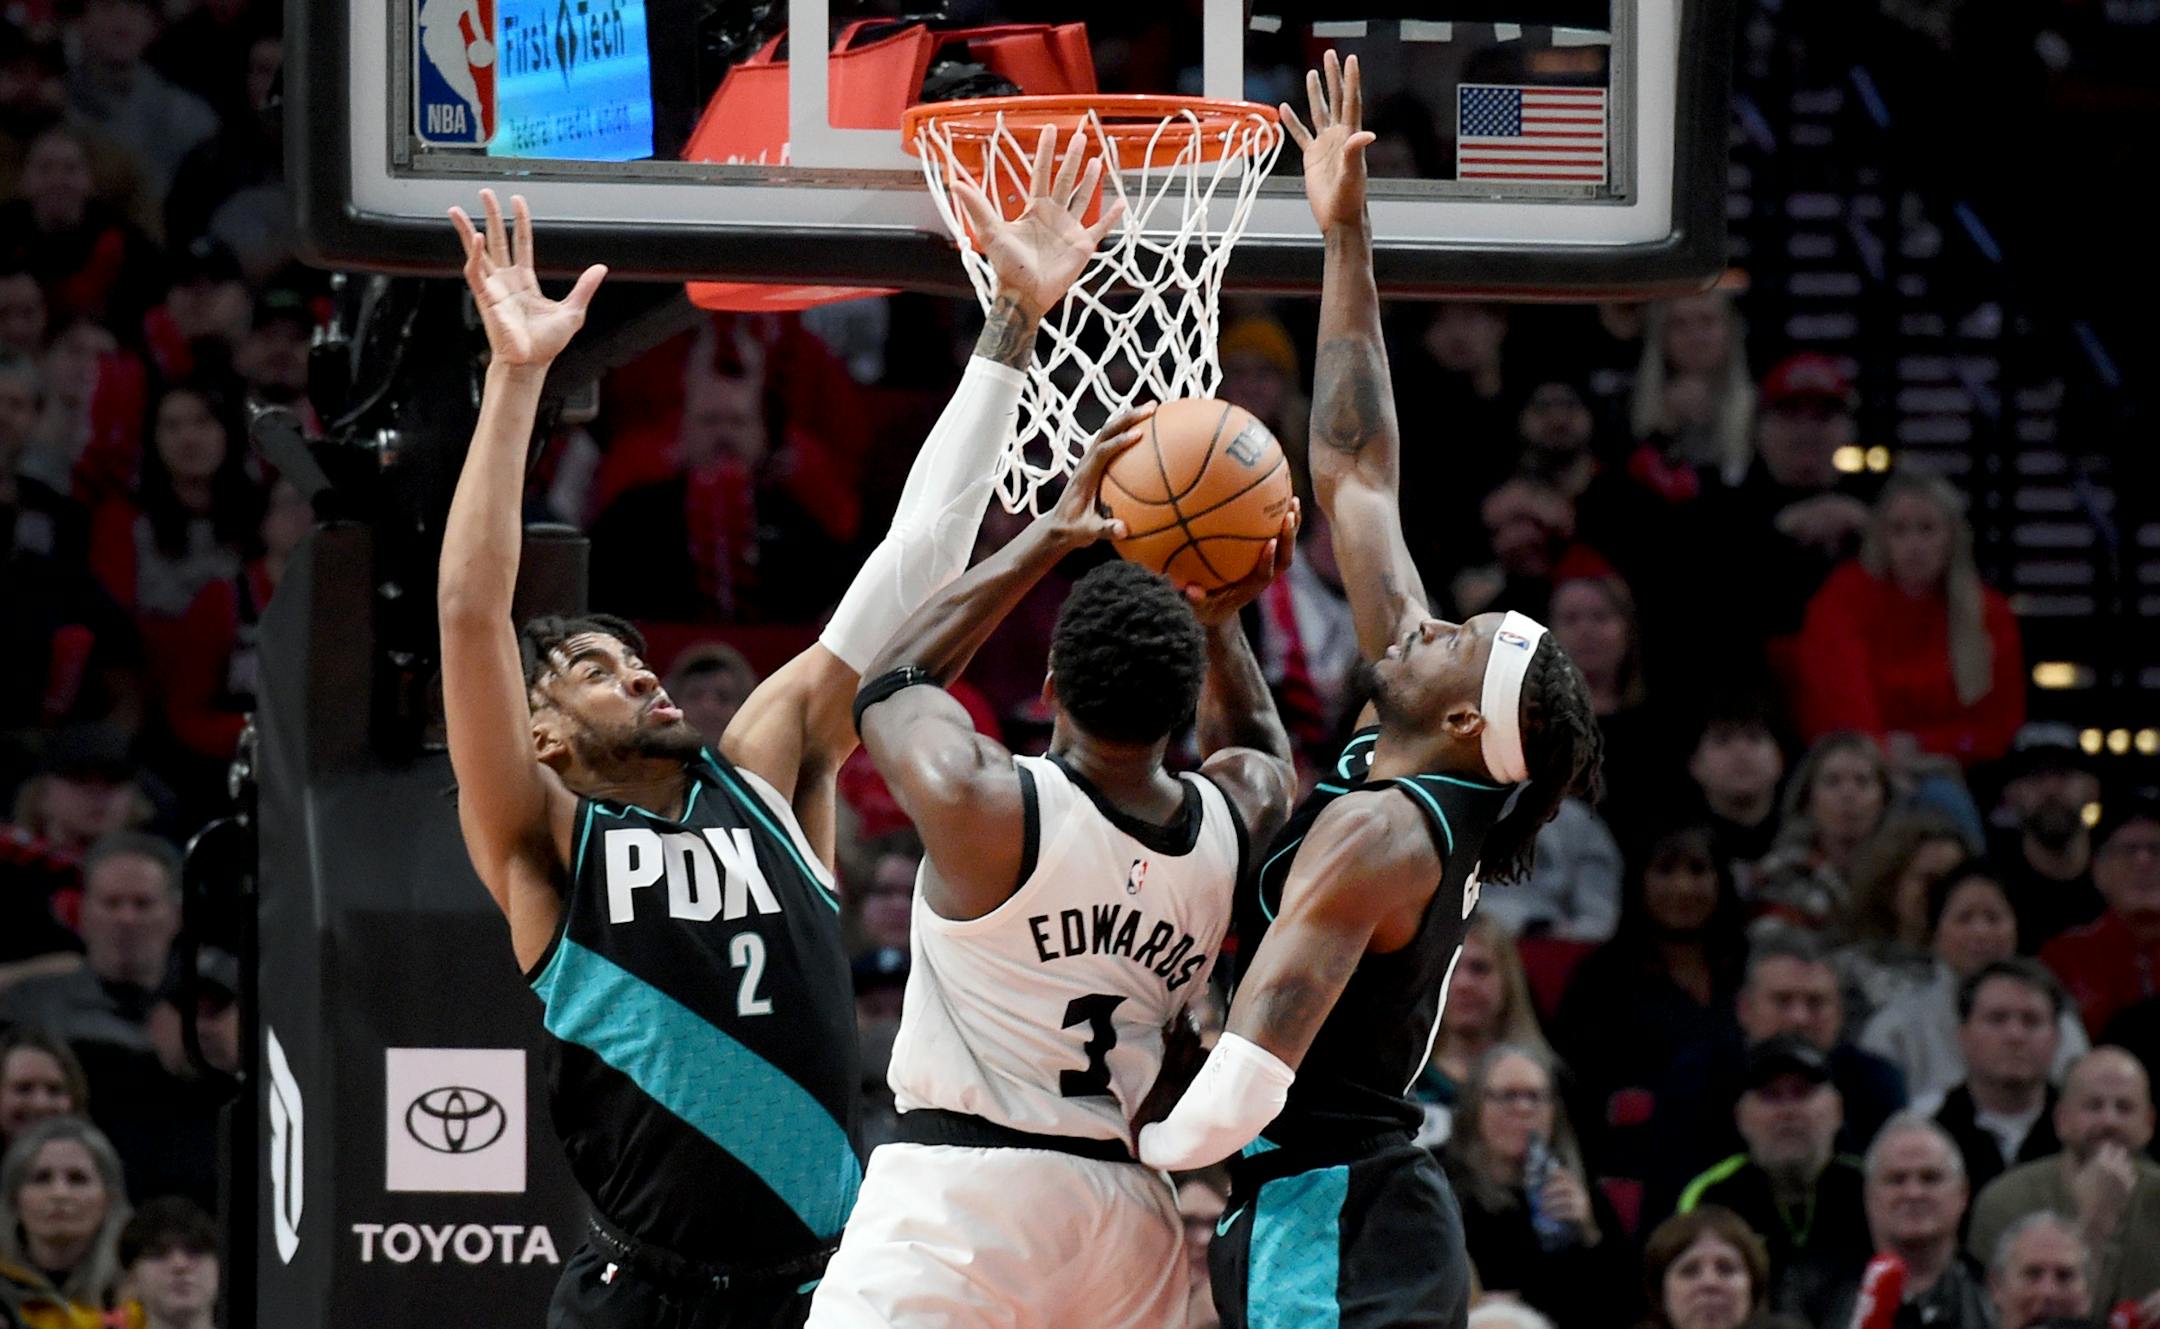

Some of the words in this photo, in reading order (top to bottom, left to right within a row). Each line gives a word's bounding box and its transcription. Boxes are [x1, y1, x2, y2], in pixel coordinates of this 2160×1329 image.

[504, 8, 551, 77] First
[577, 0, 626, 63] Tech
[427, 103, 467, 134] NBA
[604, 827, 783, 925] PDX
[729, 931, 775, 1018] 2
[1028, 903, 1207, 992] EDWARDS
[351, 1223, 561, 1265] TOYOTA
